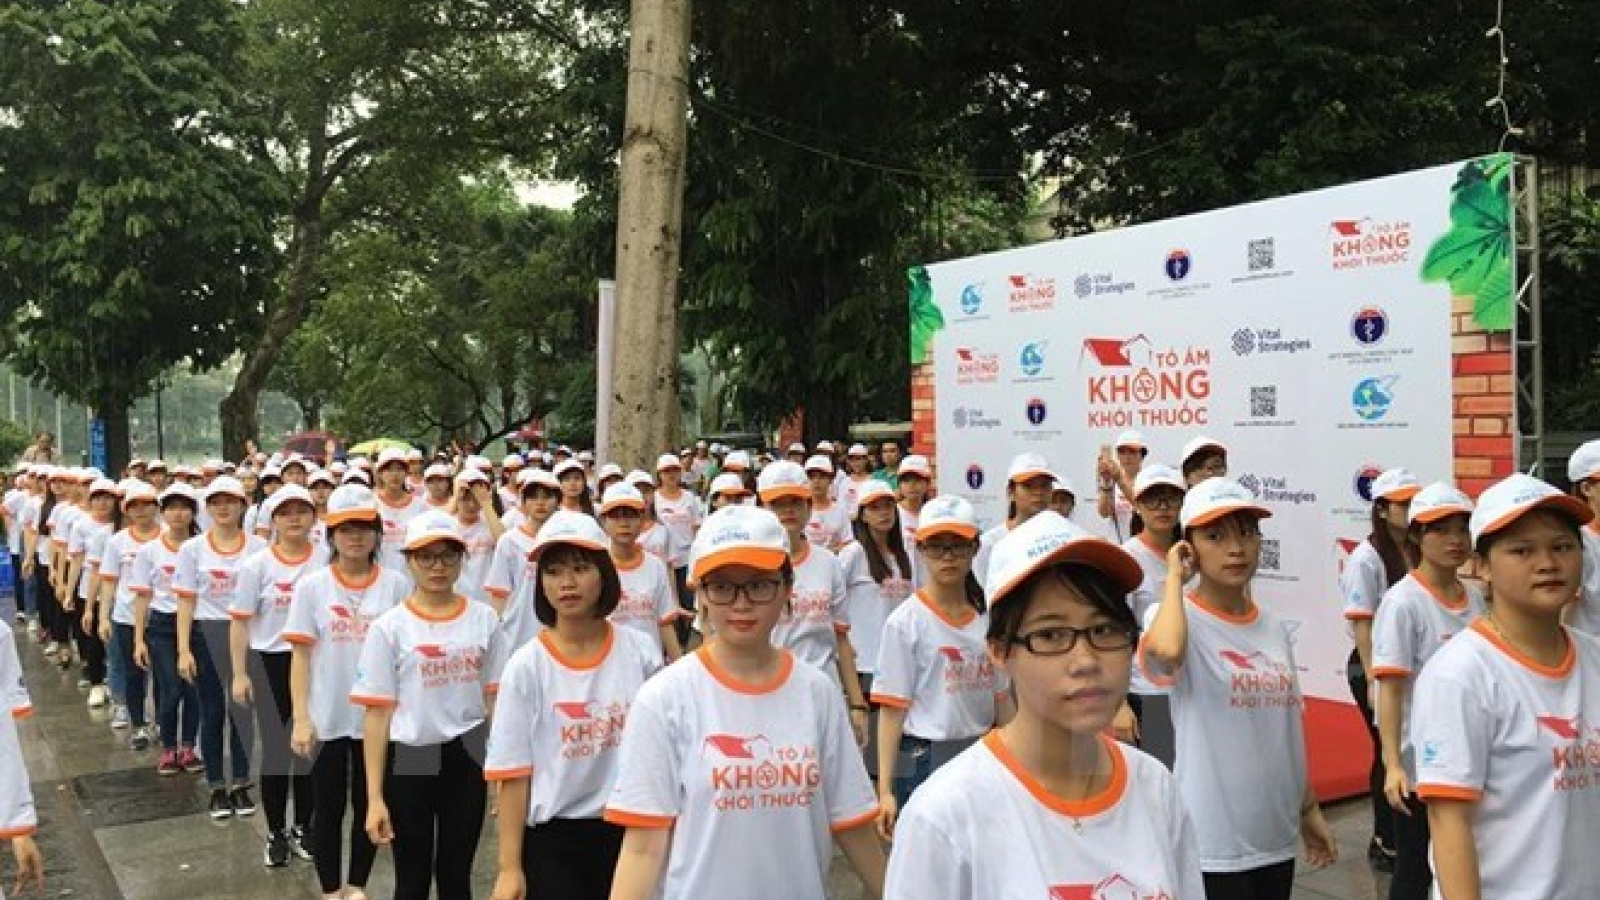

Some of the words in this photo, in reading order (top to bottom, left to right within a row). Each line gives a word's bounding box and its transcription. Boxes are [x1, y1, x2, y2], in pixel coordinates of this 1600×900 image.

[1332, 231, 1411, 257] KHÔNG
[1257, 327, 1281, 340] Vital
[1257, 338, 1311, 354] Strategies
[1087, 366, 1211, 404] KHÔNG
[1262, 476, 1286, 489] Vital
[1262, 488, 1317, 505] Strategies
[1231, 671, 1294, 693] KHÔN
[562, 714, 626, 743] KHÔN
[712, 759, 821, 790] KHÔNG
